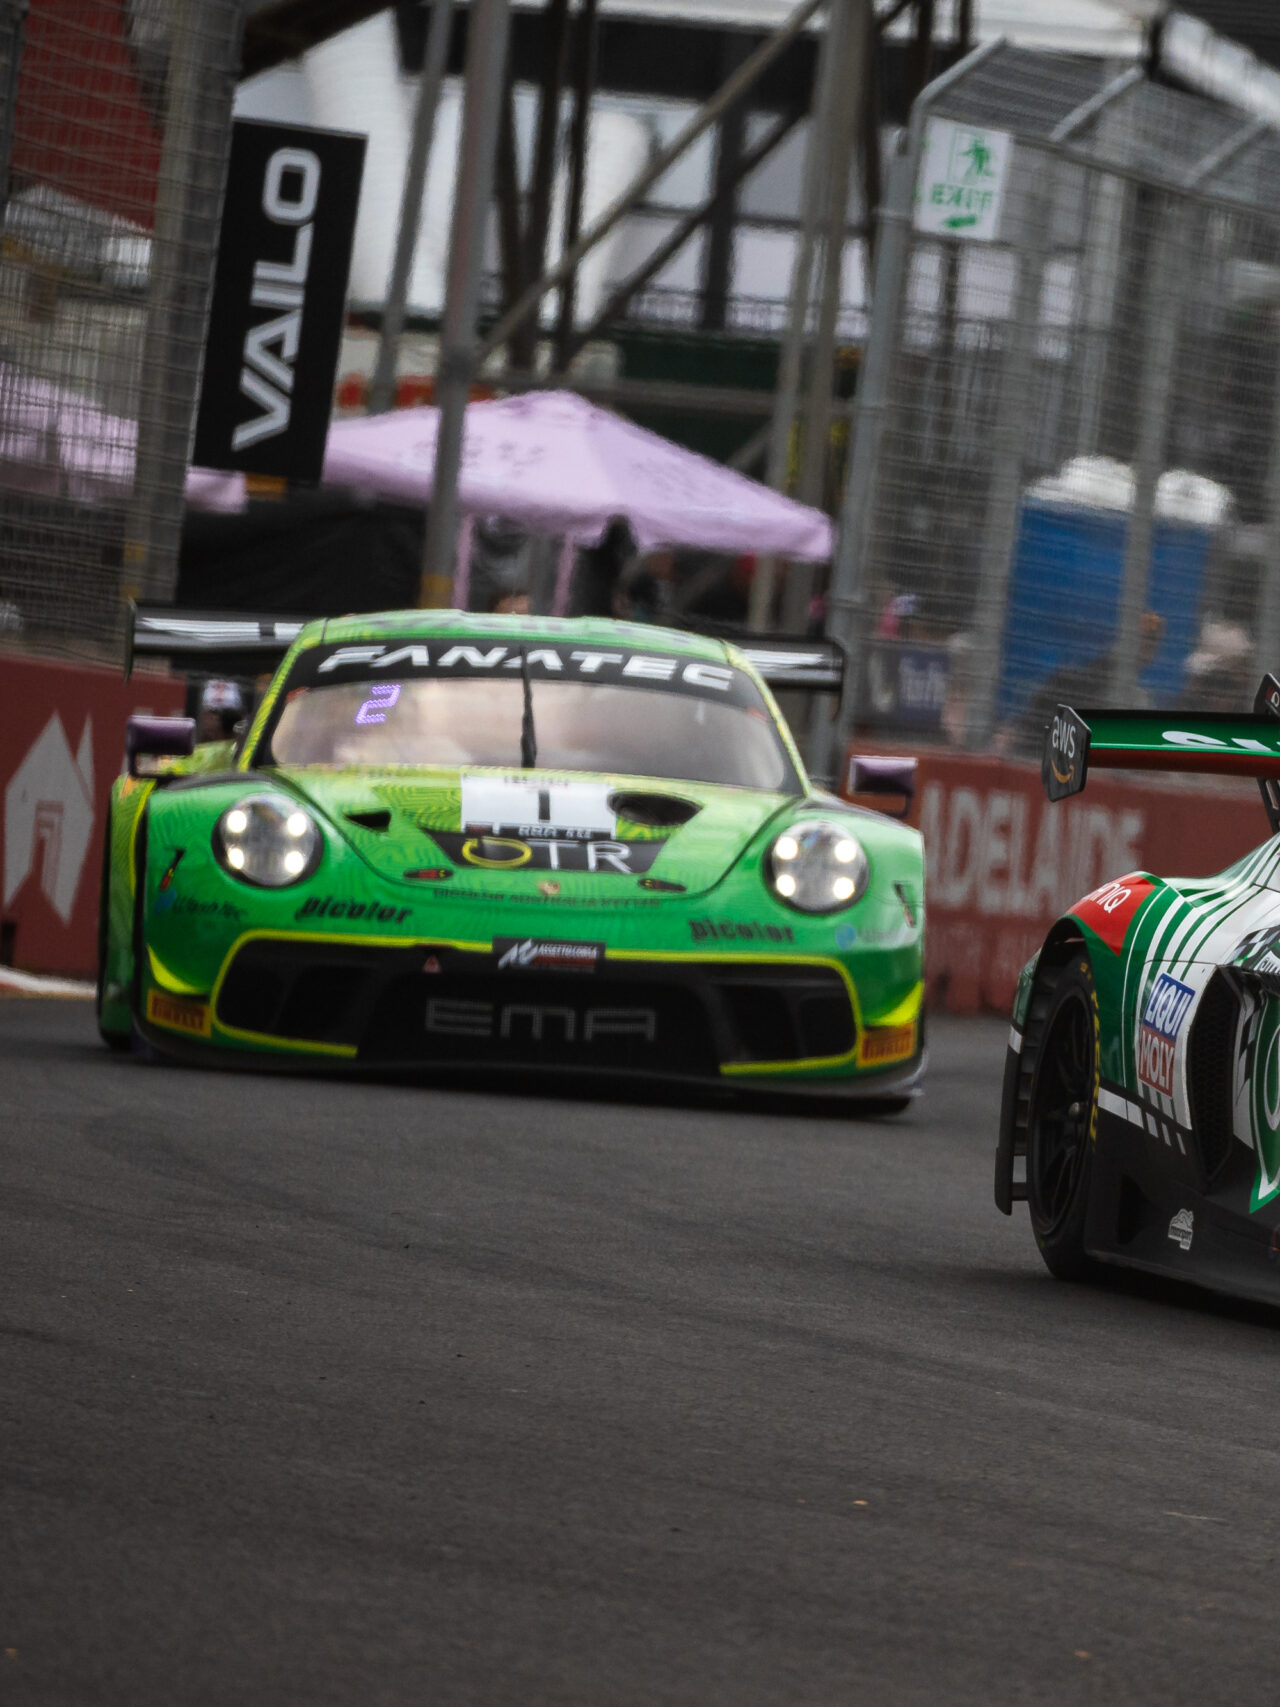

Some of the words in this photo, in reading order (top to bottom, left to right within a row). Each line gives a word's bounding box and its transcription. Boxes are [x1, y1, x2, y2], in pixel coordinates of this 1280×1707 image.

[231, 146, 321, 451] VAILO
[318, 644, 735, 690] FANATEC
[355, 684, 401, 725] 2
[1051, 715, 1076, 759] aws
[461, 835, 633, 875] OTR
[1145, 978, 1193, 1036] LIQUI
[1140, 1029, 1175, 1092] MOLY
